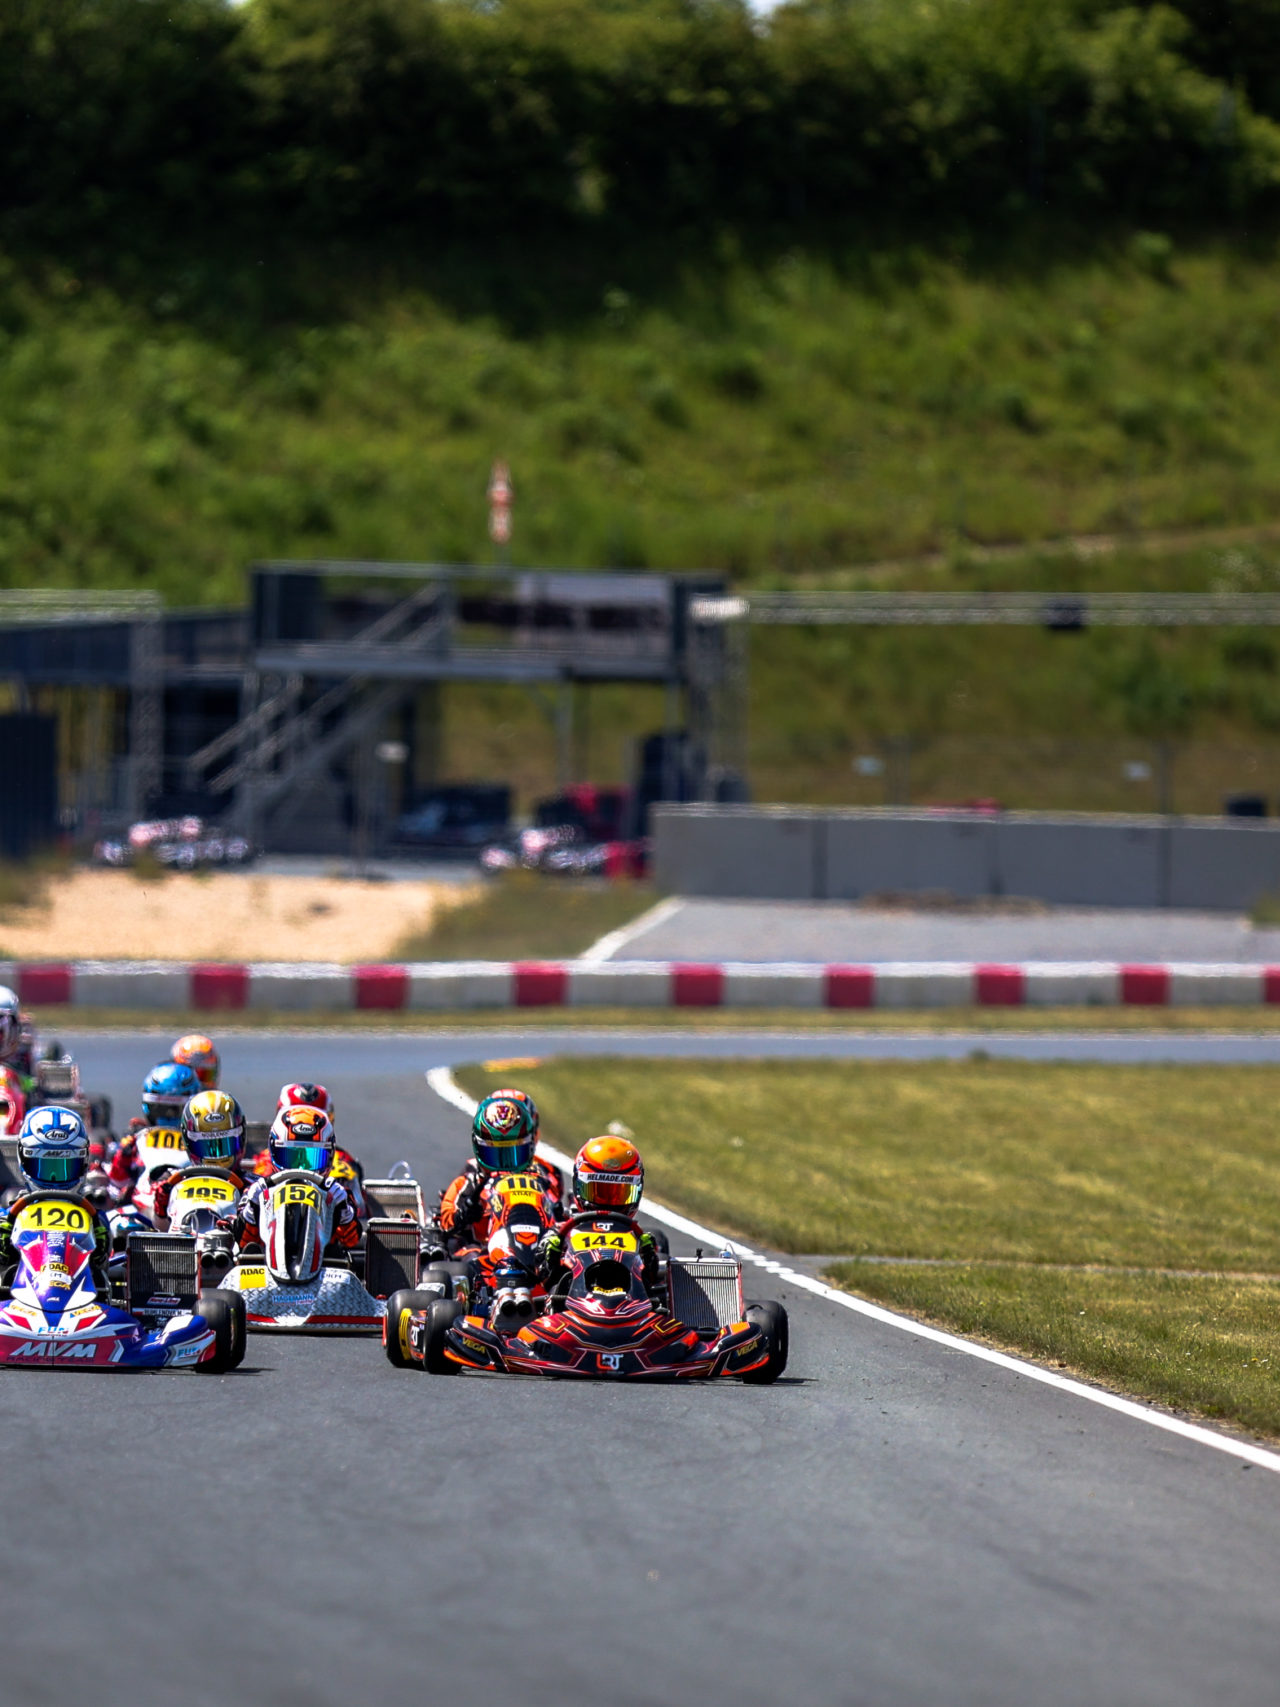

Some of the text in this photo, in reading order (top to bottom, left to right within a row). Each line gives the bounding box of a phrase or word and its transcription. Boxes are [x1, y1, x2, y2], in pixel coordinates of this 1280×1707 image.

[45, 1130, 67, 1139] Arai
[293, 1124, 313, 1132] Arai
[587, 1173, 634, 1182] HELMADE.COM
[183, 1187, 227, 1200] 195
[278, 1185, 320, 1209] 154
[30, 1207, 84, 1229] 120
[582, 1235, 627, 1249] 144
[240, 1268, 265, 1276] ADAC
[9, 1341, 98, 1358] MVM
[462, 1336, 486, 1354] VEGA
[736, 1340, 758, 1357] VEGA
